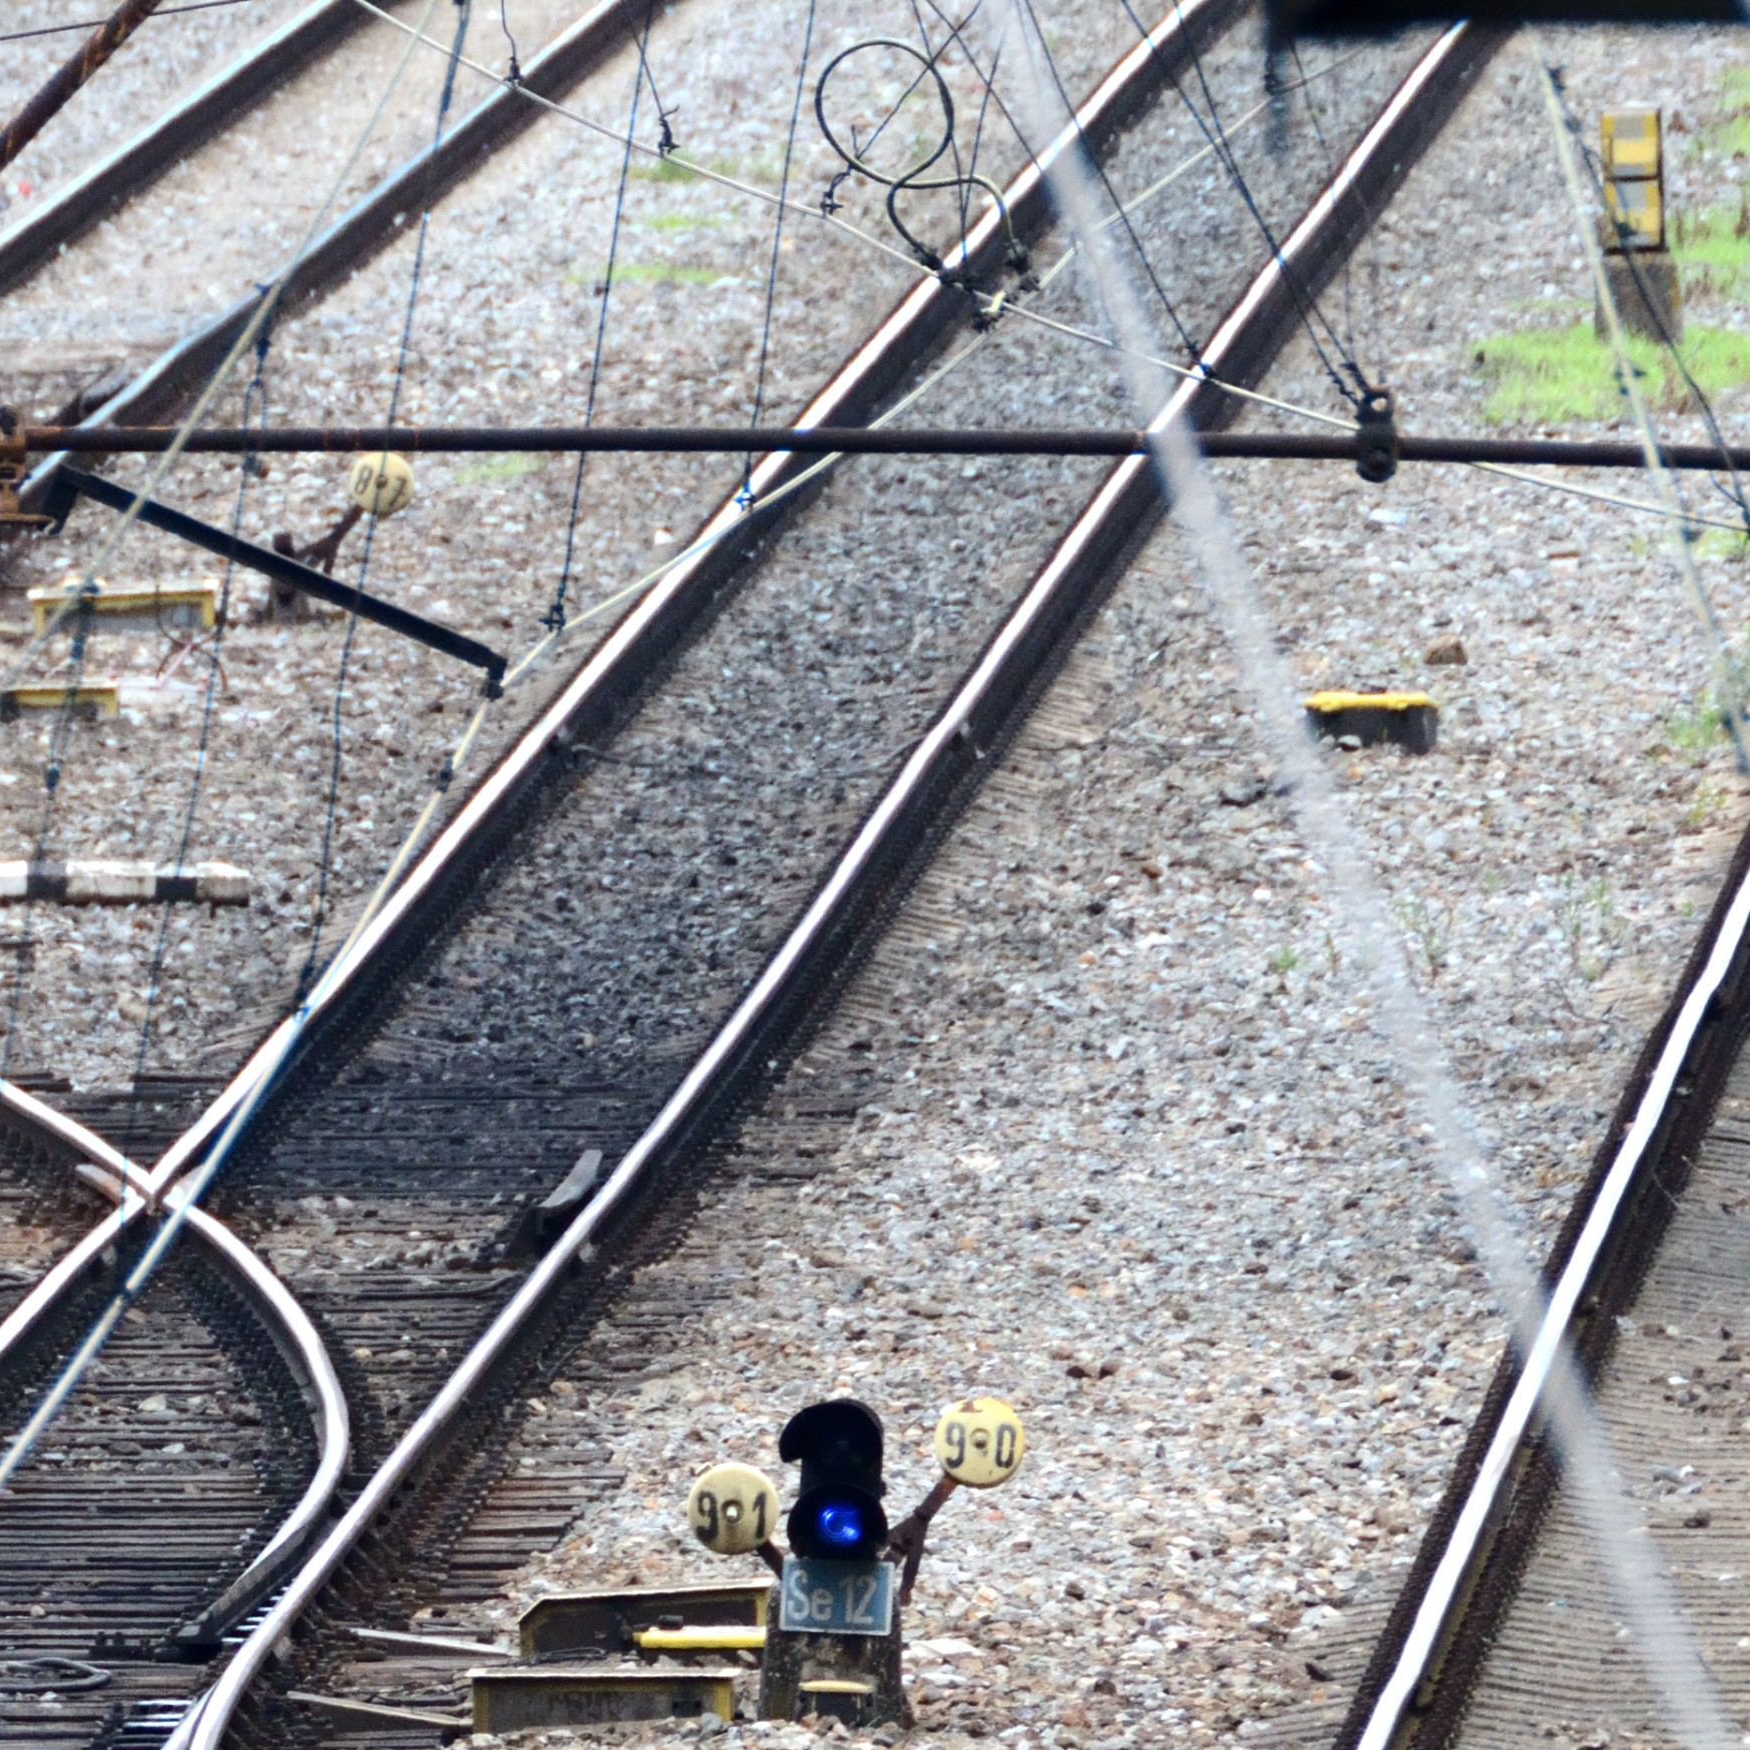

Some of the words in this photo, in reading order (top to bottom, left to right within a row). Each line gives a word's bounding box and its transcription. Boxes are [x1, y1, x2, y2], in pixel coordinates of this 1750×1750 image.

[354, 465, 407, 509] 87
[946, 1422, 1016, 1470] 90
[696, 1491, 767, 1544] 91
[787, 1571, 832, 1623] Se
[844, 1575, 877, 1624] 12
